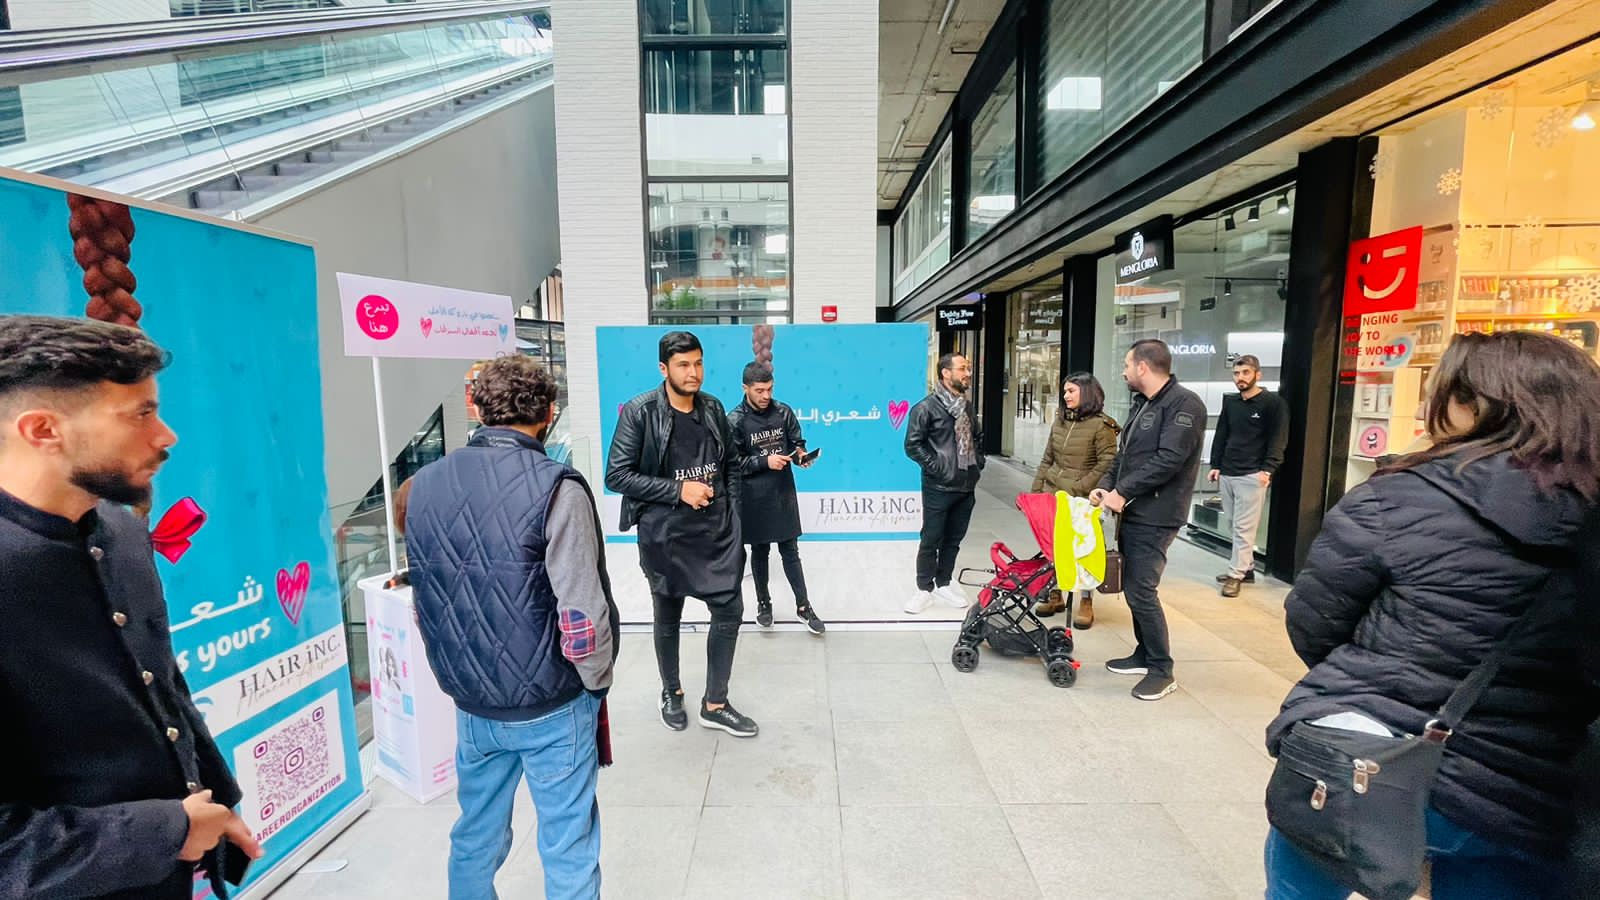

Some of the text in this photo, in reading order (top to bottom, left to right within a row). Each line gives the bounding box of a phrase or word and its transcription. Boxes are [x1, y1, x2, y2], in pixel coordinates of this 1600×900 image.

[1120, 256, 1159, 277] MENGLORIA
[1366, 331, 1380, 341] TO
[1167, 344, 1217, 355] NGLORIA
[821, 405, 881, 427] شعري
[197, 617, 271, 672] yours
[254, 773, 342, 842] AREERORGANIZATION
